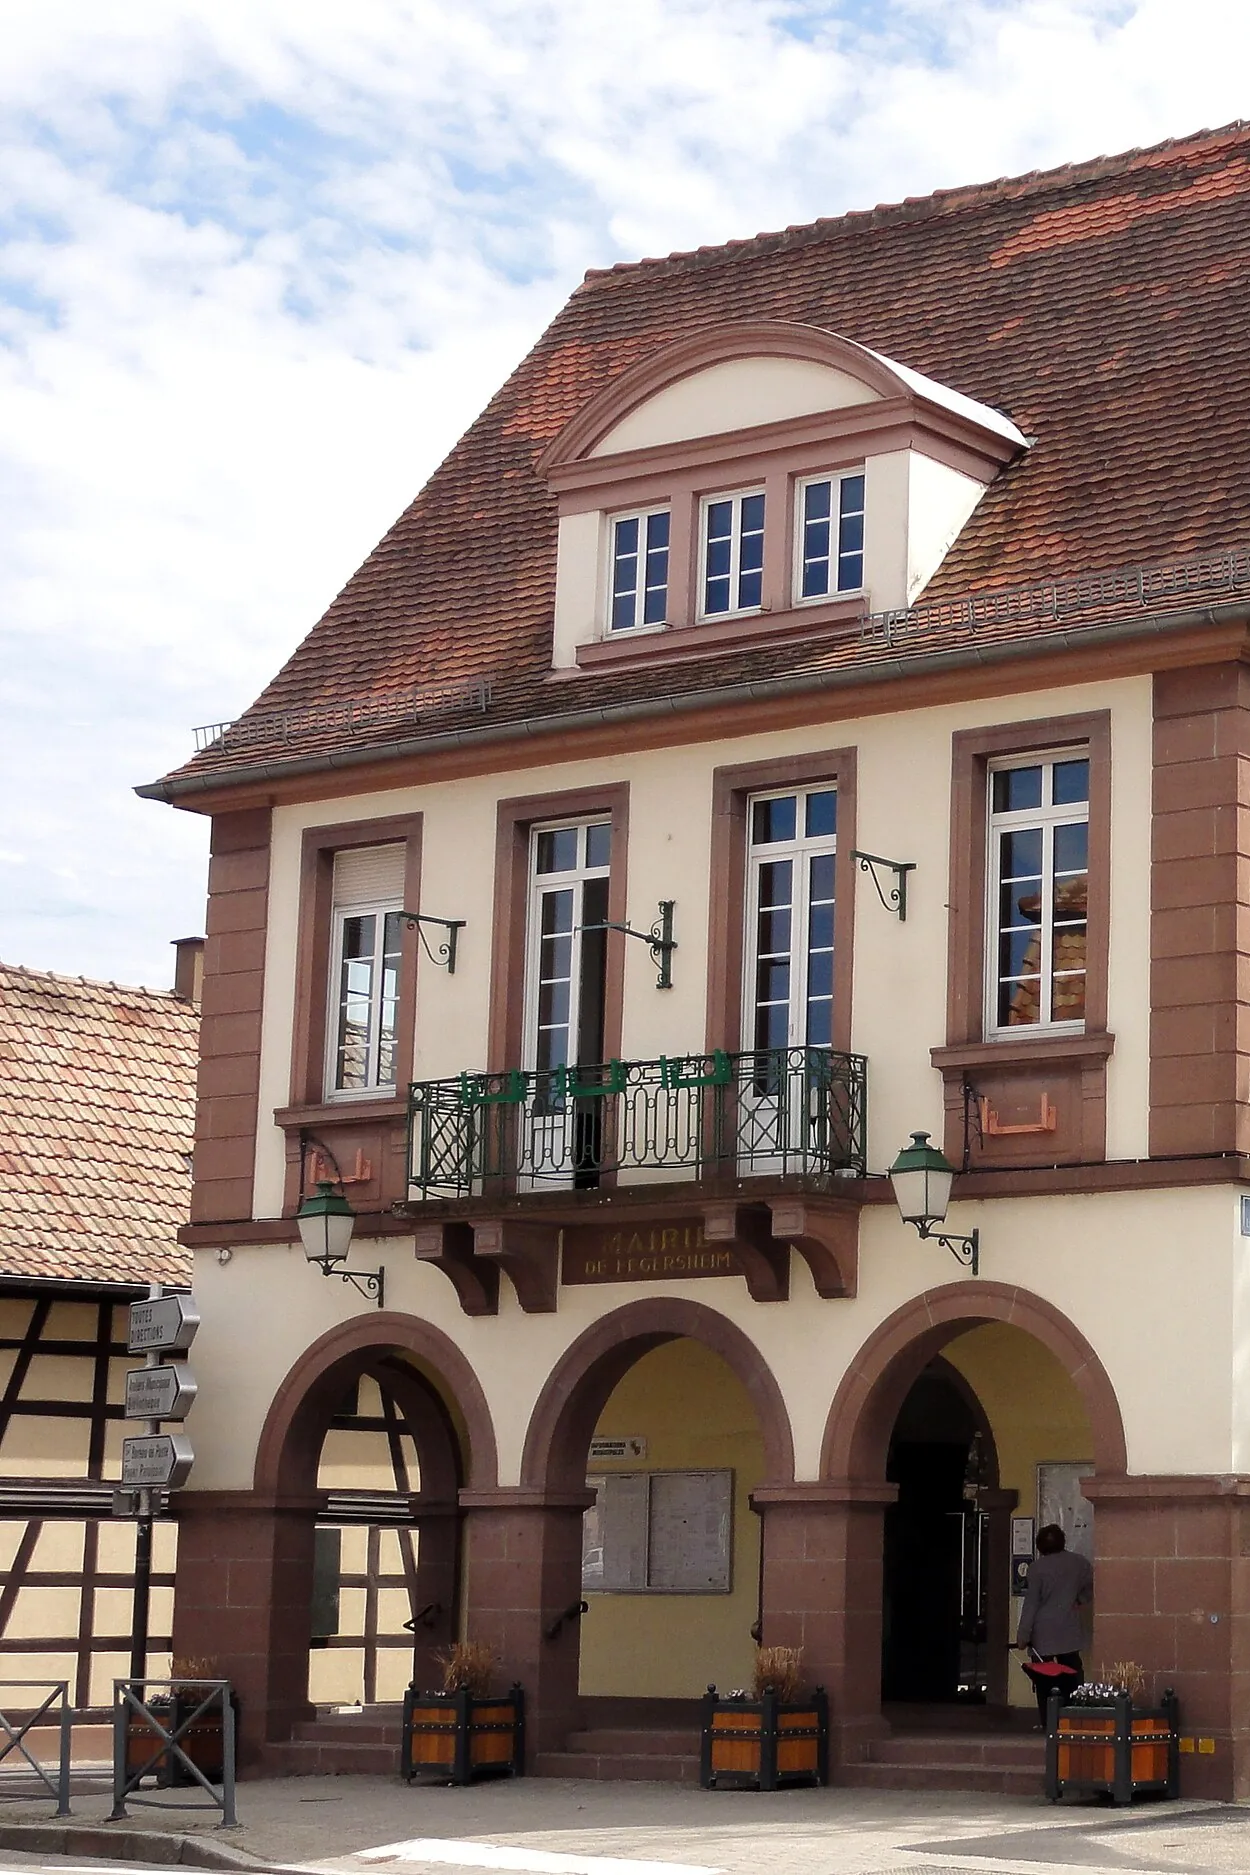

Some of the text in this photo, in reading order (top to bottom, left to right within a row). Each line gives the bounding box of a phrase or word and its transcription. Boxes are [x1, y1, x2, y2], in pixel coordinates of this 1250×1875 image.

[602, 1227, 712, 1254] MAIRIE
[585, 1252, 732, 1275] DE FEGERSHEIM
[132, 1309, 152, 1324] TOUTES
[132, 1325, 163, 1343] DIRECTIONS
